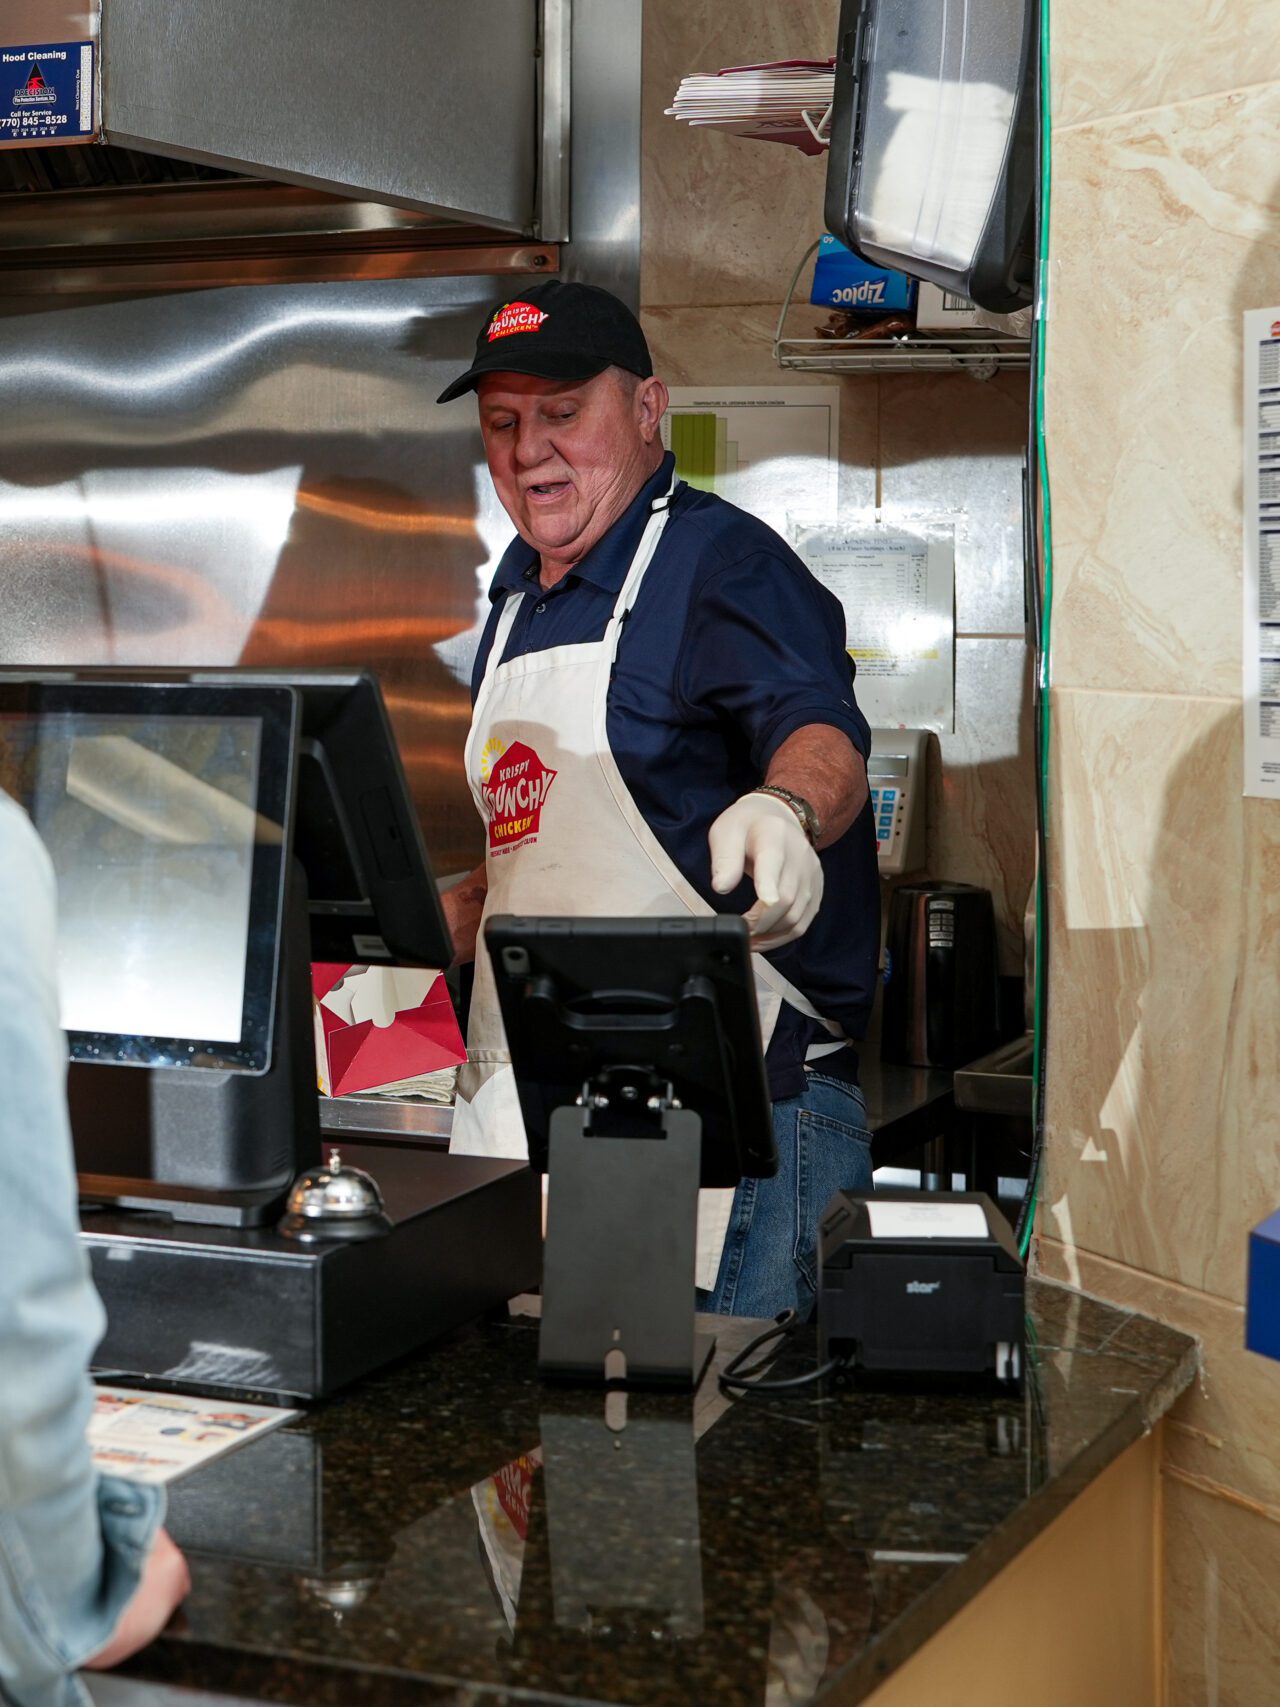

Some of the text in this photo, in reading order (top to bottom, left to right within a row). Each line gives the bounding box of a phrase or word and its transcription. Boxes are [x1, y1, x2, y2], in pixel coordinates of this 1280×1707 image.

[2, 50, 67, 63] Hood Cleaning
[832, 280, 886, 304] Ziploc
[486, 311, 550, 336] KRUNCHY
[499, 759, 530, 782] KRISPY
[482, 770, 554, 822] KRUNCHY
[906, 1280, 939, 1293] star
